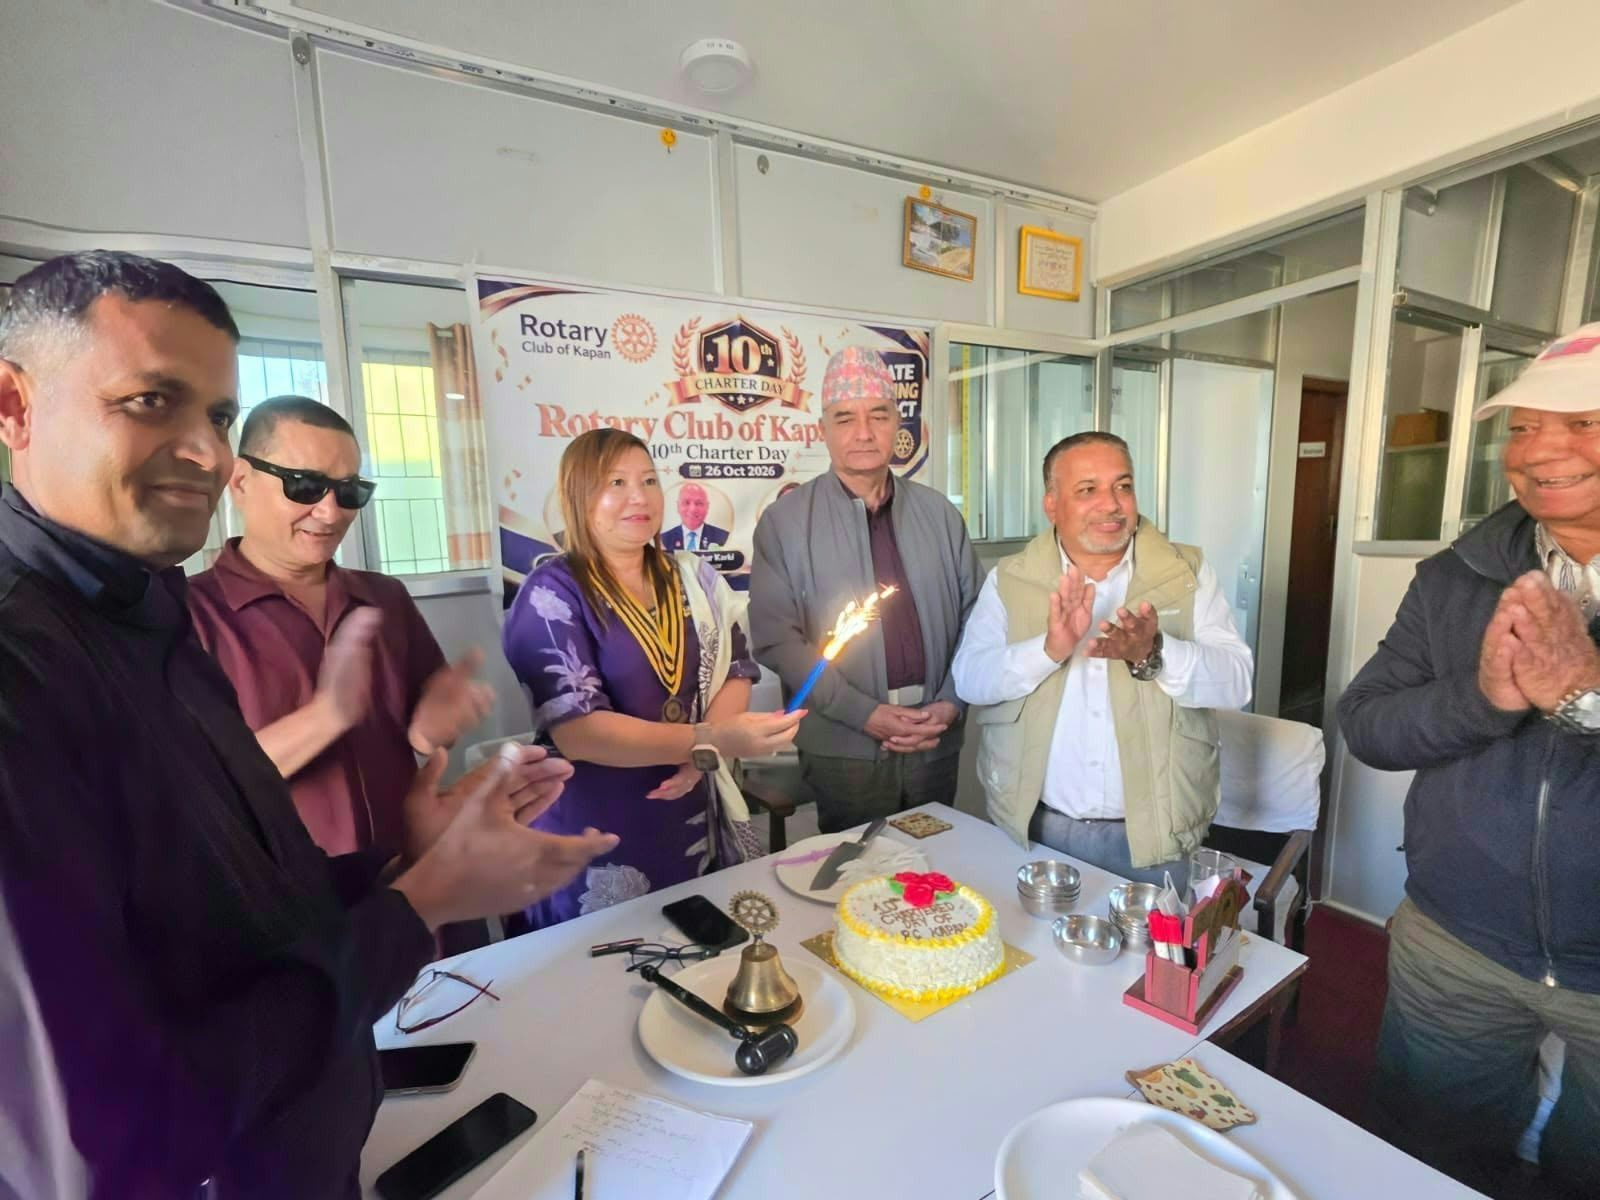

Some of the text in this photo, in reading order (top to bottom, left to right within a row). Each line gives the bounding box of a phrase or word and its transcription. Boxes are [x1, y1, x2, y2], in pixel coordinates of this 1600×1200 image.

[520, 313, 607, 348] Rotary
[522, 340, 611, 360] Club of Kapan
[695, 377, 786, 395] CHARTER DAY
[664, 410, 733, 440] Club
[738, 414, 766, 442] of
[651, 442, 789, 464] 10th Charter Day
[705, 465, 776, 477] 26 Oct 2026
